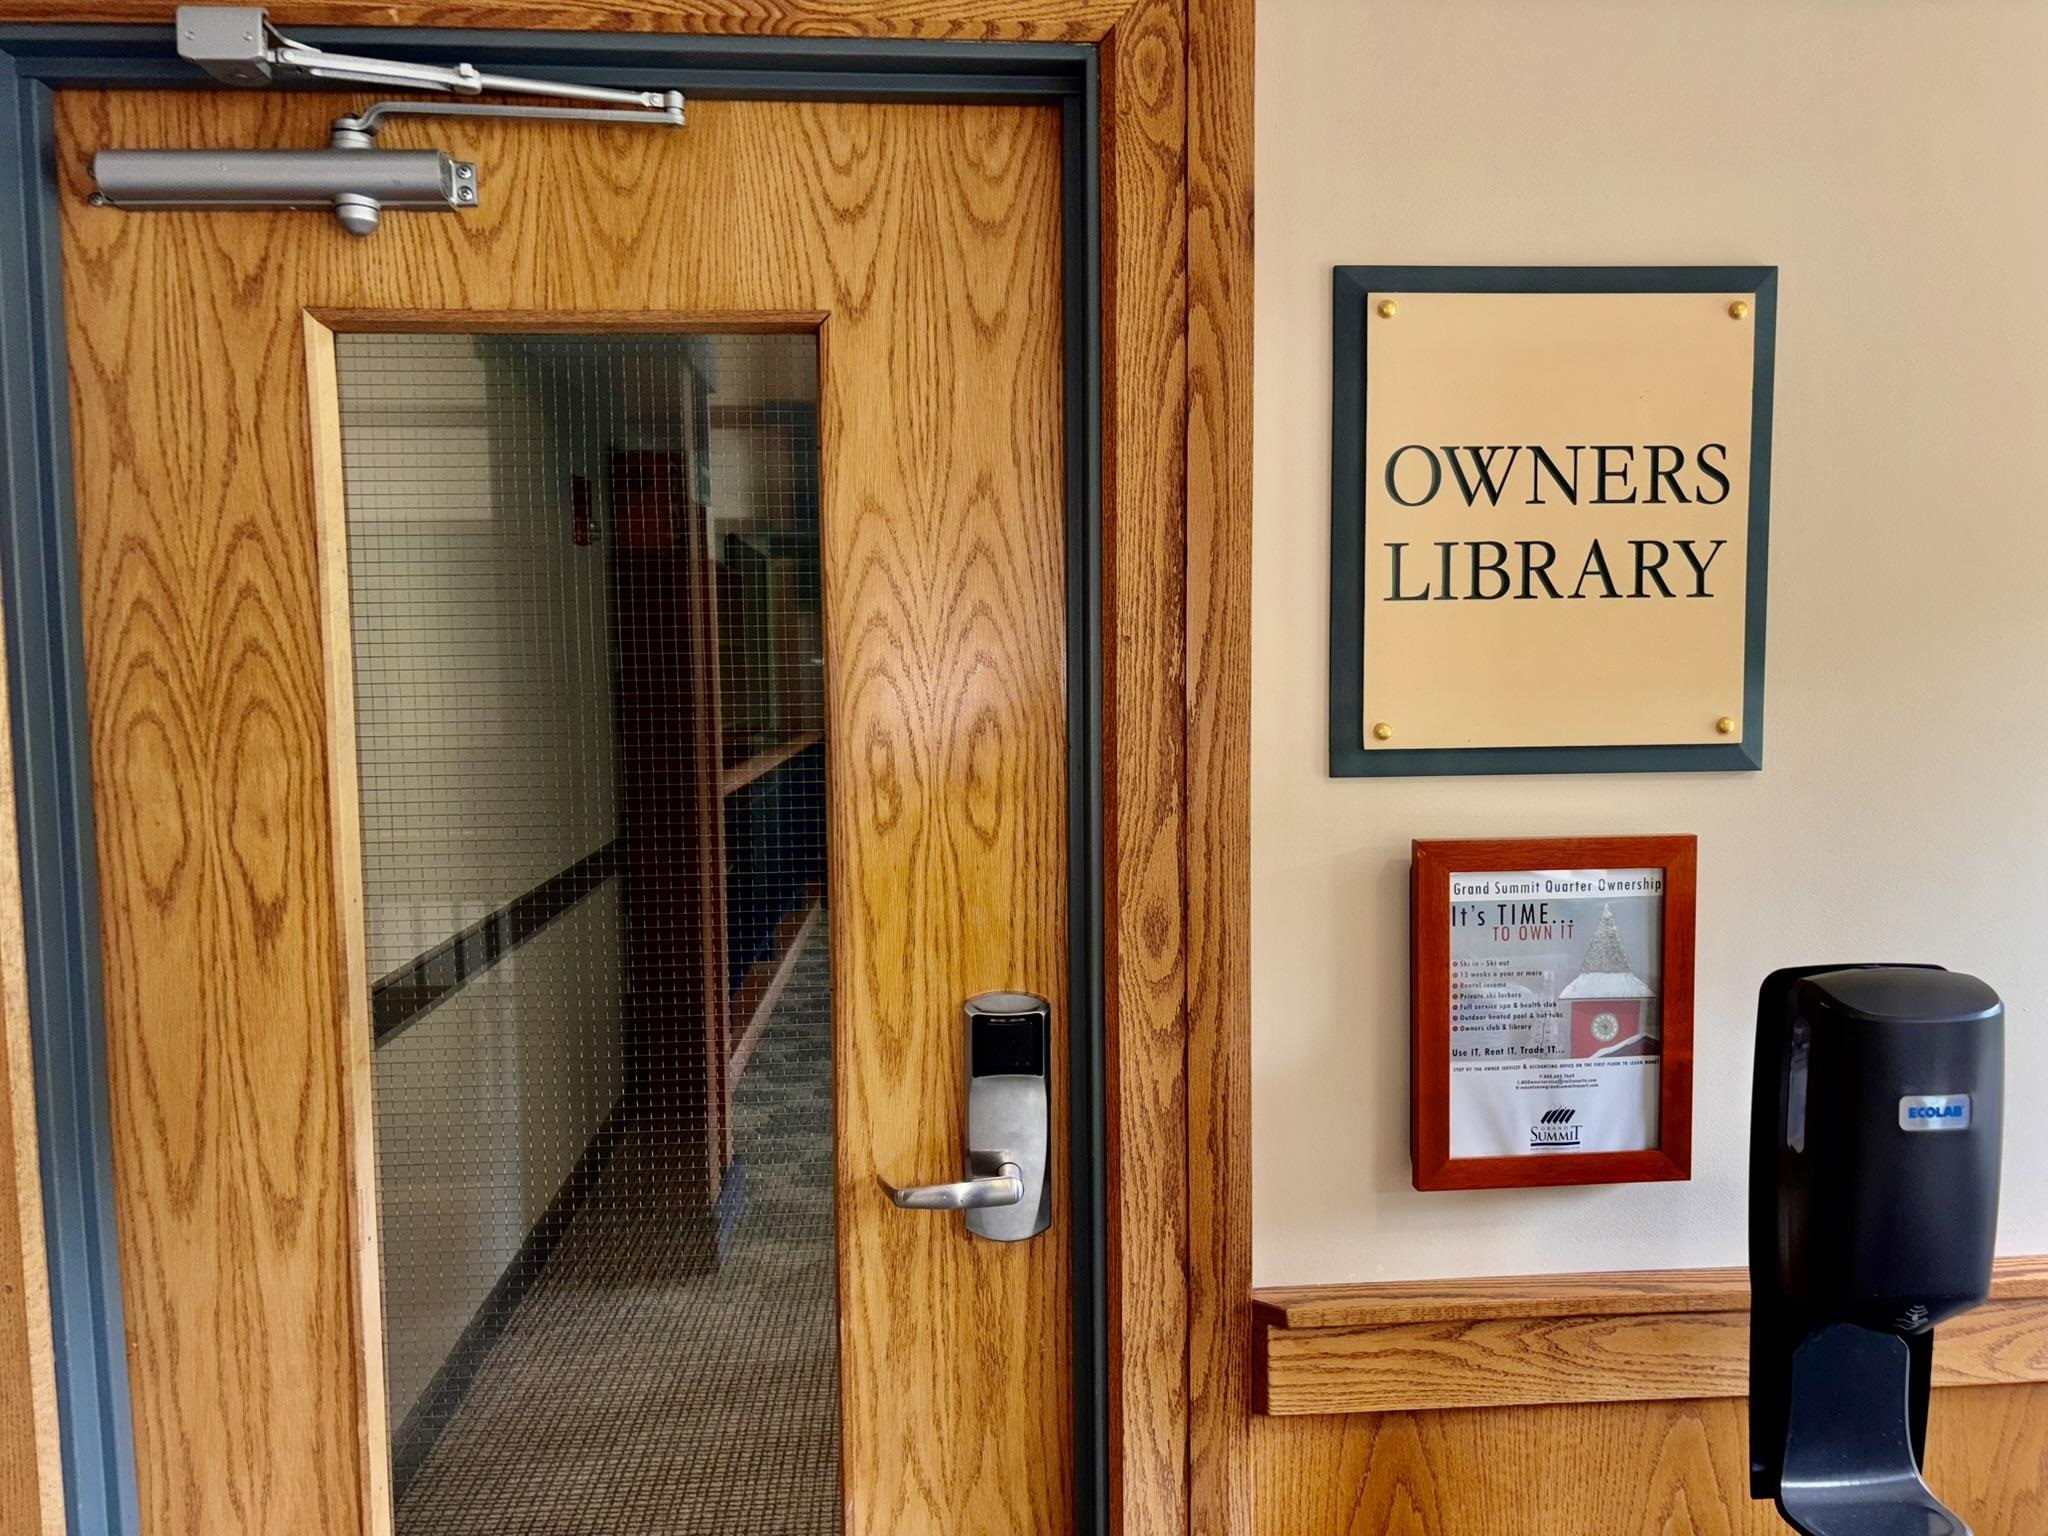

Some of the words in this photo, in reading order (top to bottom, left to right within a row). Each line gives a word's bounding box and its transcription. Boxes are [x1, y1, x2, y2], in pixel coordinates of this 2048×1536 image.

[1384, 443, 1730, 507] OWNERS
[1383, 538, 1727, 601] LIBRARY
[1453, 881, 1490, 896] Grand
[1494, 880, 1540, 895] Summit
[1545, 879, 1593, 894] Quarter
[1598, 877, 1662, 893] Ownership
[1452, 904, 1486, 927] It's
[1496, 903, 1574, 926] TIME...
[1493, 926, 1510, 942] TO
[1518, 924, 1552, 941] OWN
[1561, 923, 1575, 940] IT
[1486, 959, 1497, 967] Ski
[1470, 970, 1491, 978] weeks
[1499, 971, 1514, 979] year
[1498, 991, 1522, 999] lockers
[1460, 1002, 1473, 1010] Full
[1520, 1001, 1542, 1009] health
[1488, 1012, 1511, 1020] heated
[1512, 1012, 1528, 1020] pool
[1549, 1011, 1563, 1019] tubs
[1508, 1023, 1532, 1031] library
[1452, 1048, 1468, 1057] Use
[1471, 1048, 1481, 1057] IT,
[1484, 1047, 1504, 1056] Rent
[1520, 1045, 1545, 1055] Trade
[1547, 1045, 1565, 1054] IT...
[1908, 1105, 1963, 1119] ECOLAB
[1529, 1125, 1583, 1142] SUMMIT
